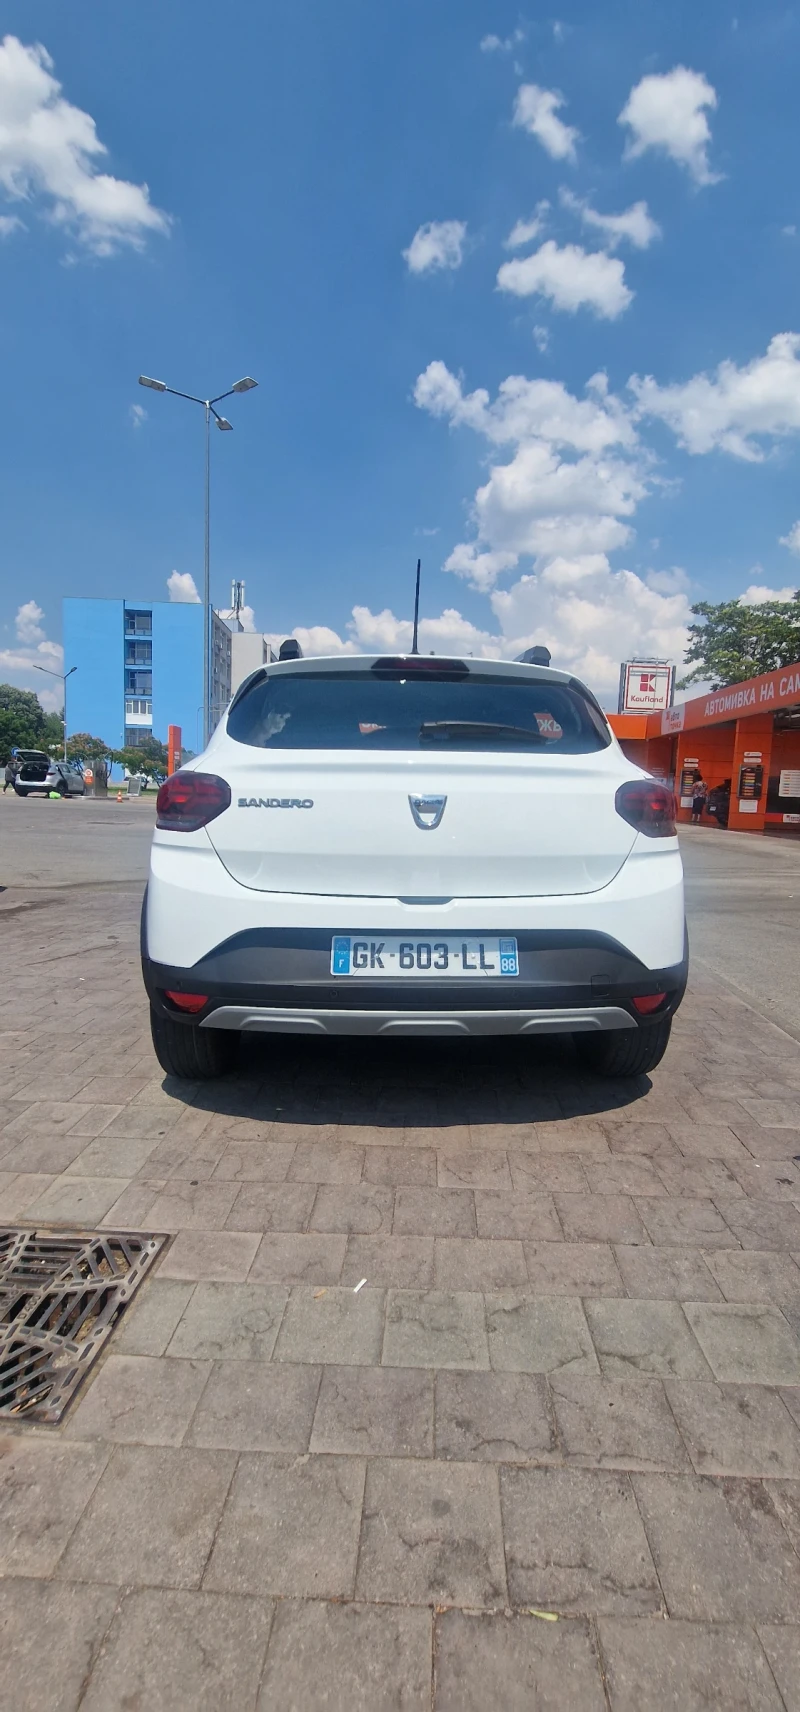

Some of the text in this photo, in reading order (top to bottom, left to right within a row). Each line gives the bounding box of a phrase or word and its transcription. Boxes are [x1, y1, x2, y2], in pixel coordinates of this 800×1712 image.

[630, 695, 664, 703] Kaufland
[704, 688, 756, 717] АВТОМИВКА
[759, 682, 775, 702] НА
[237, 798, 314, 809] SANDERO
[352, 942, 495, 970] GK-603-LL
[338, 959, 344, 968] F
[501, 958, 516, 972] 88
